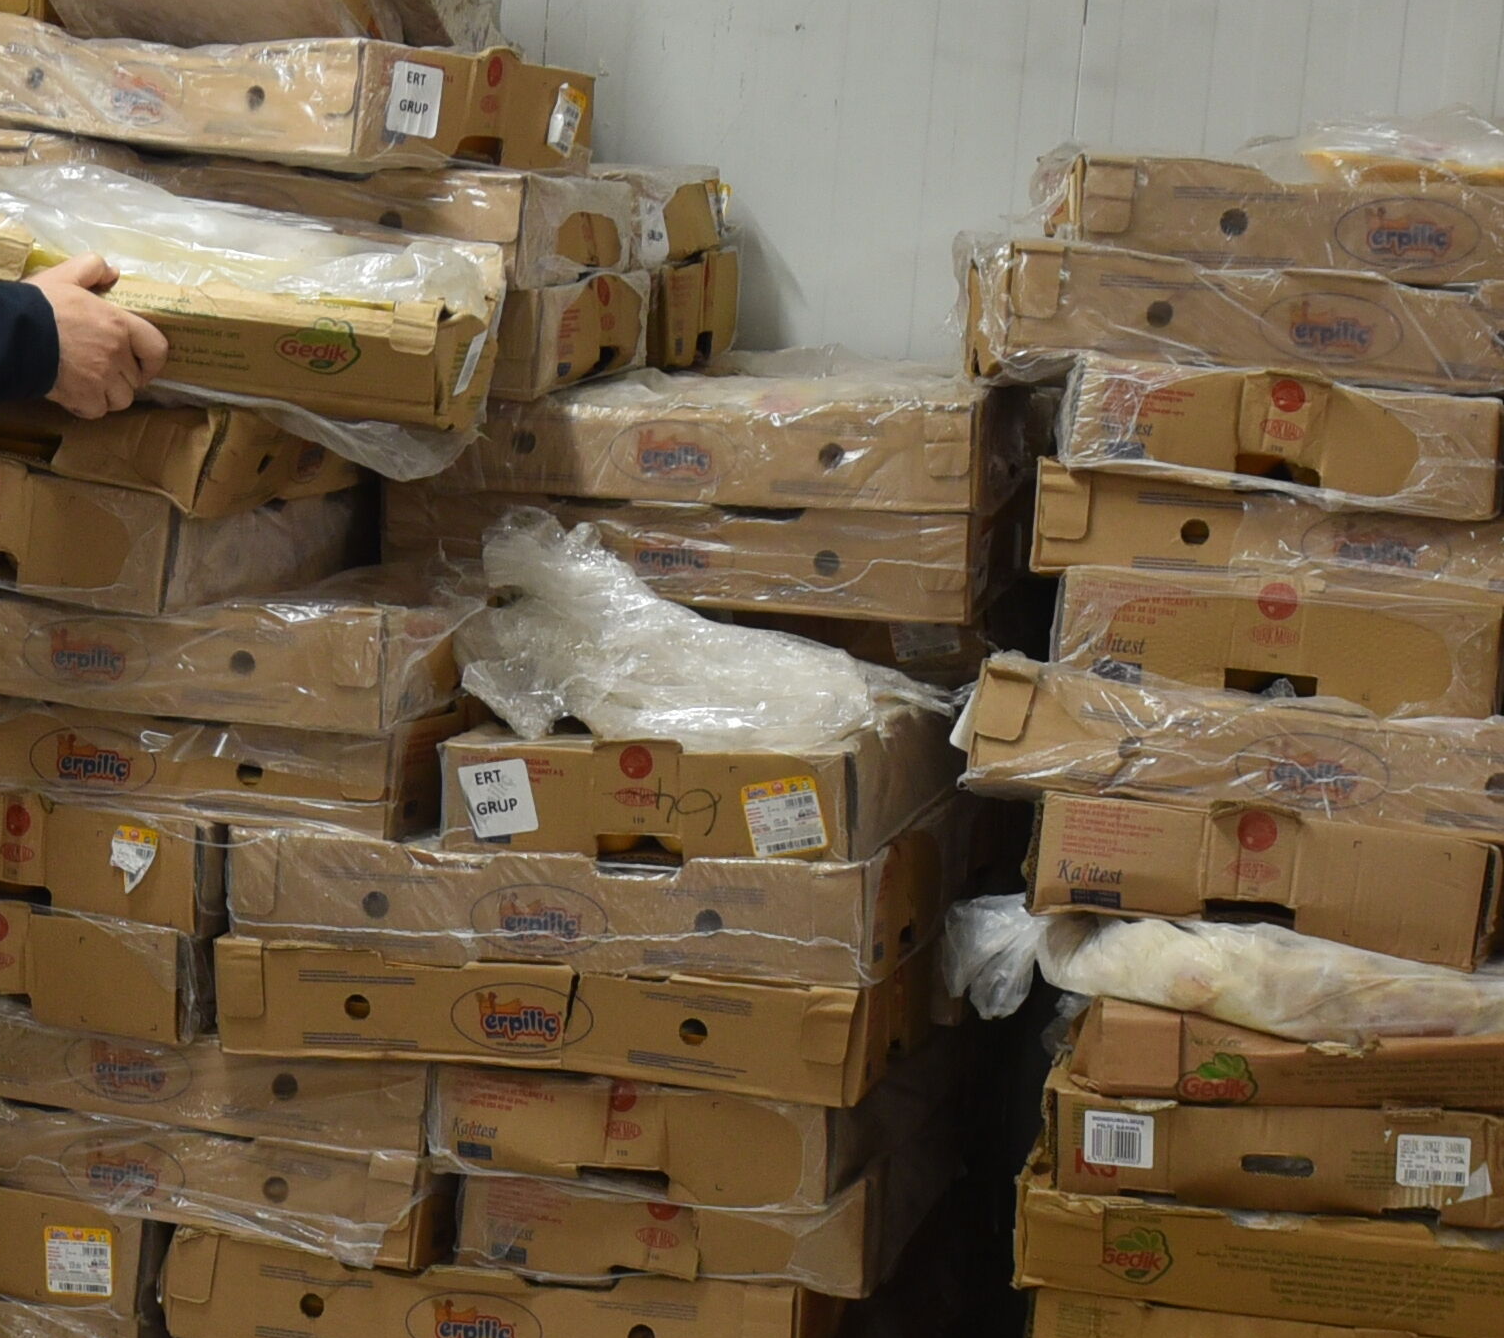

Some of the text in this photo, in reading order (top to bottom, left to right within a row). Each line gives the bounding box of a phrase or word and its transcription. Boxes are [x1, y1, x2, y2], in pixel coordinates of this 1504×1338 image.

[406, 70, 428, 86] ERT
[398, 99, 429, 116] GRUP
[1367, 223, 1452, 255] erpiliç
[277, 333, 350, 365] Gedik
[59, 752, 131, 782] erpiliç
[473, 768, 503, 787] ERT
[476, 796, 519, 817] GRUP
[1056, 859, 1123, 888] Kalitest
[484, 1011, 559, 1041] erpiliç
[1180, 1075, 1248, 1105] Gedik
